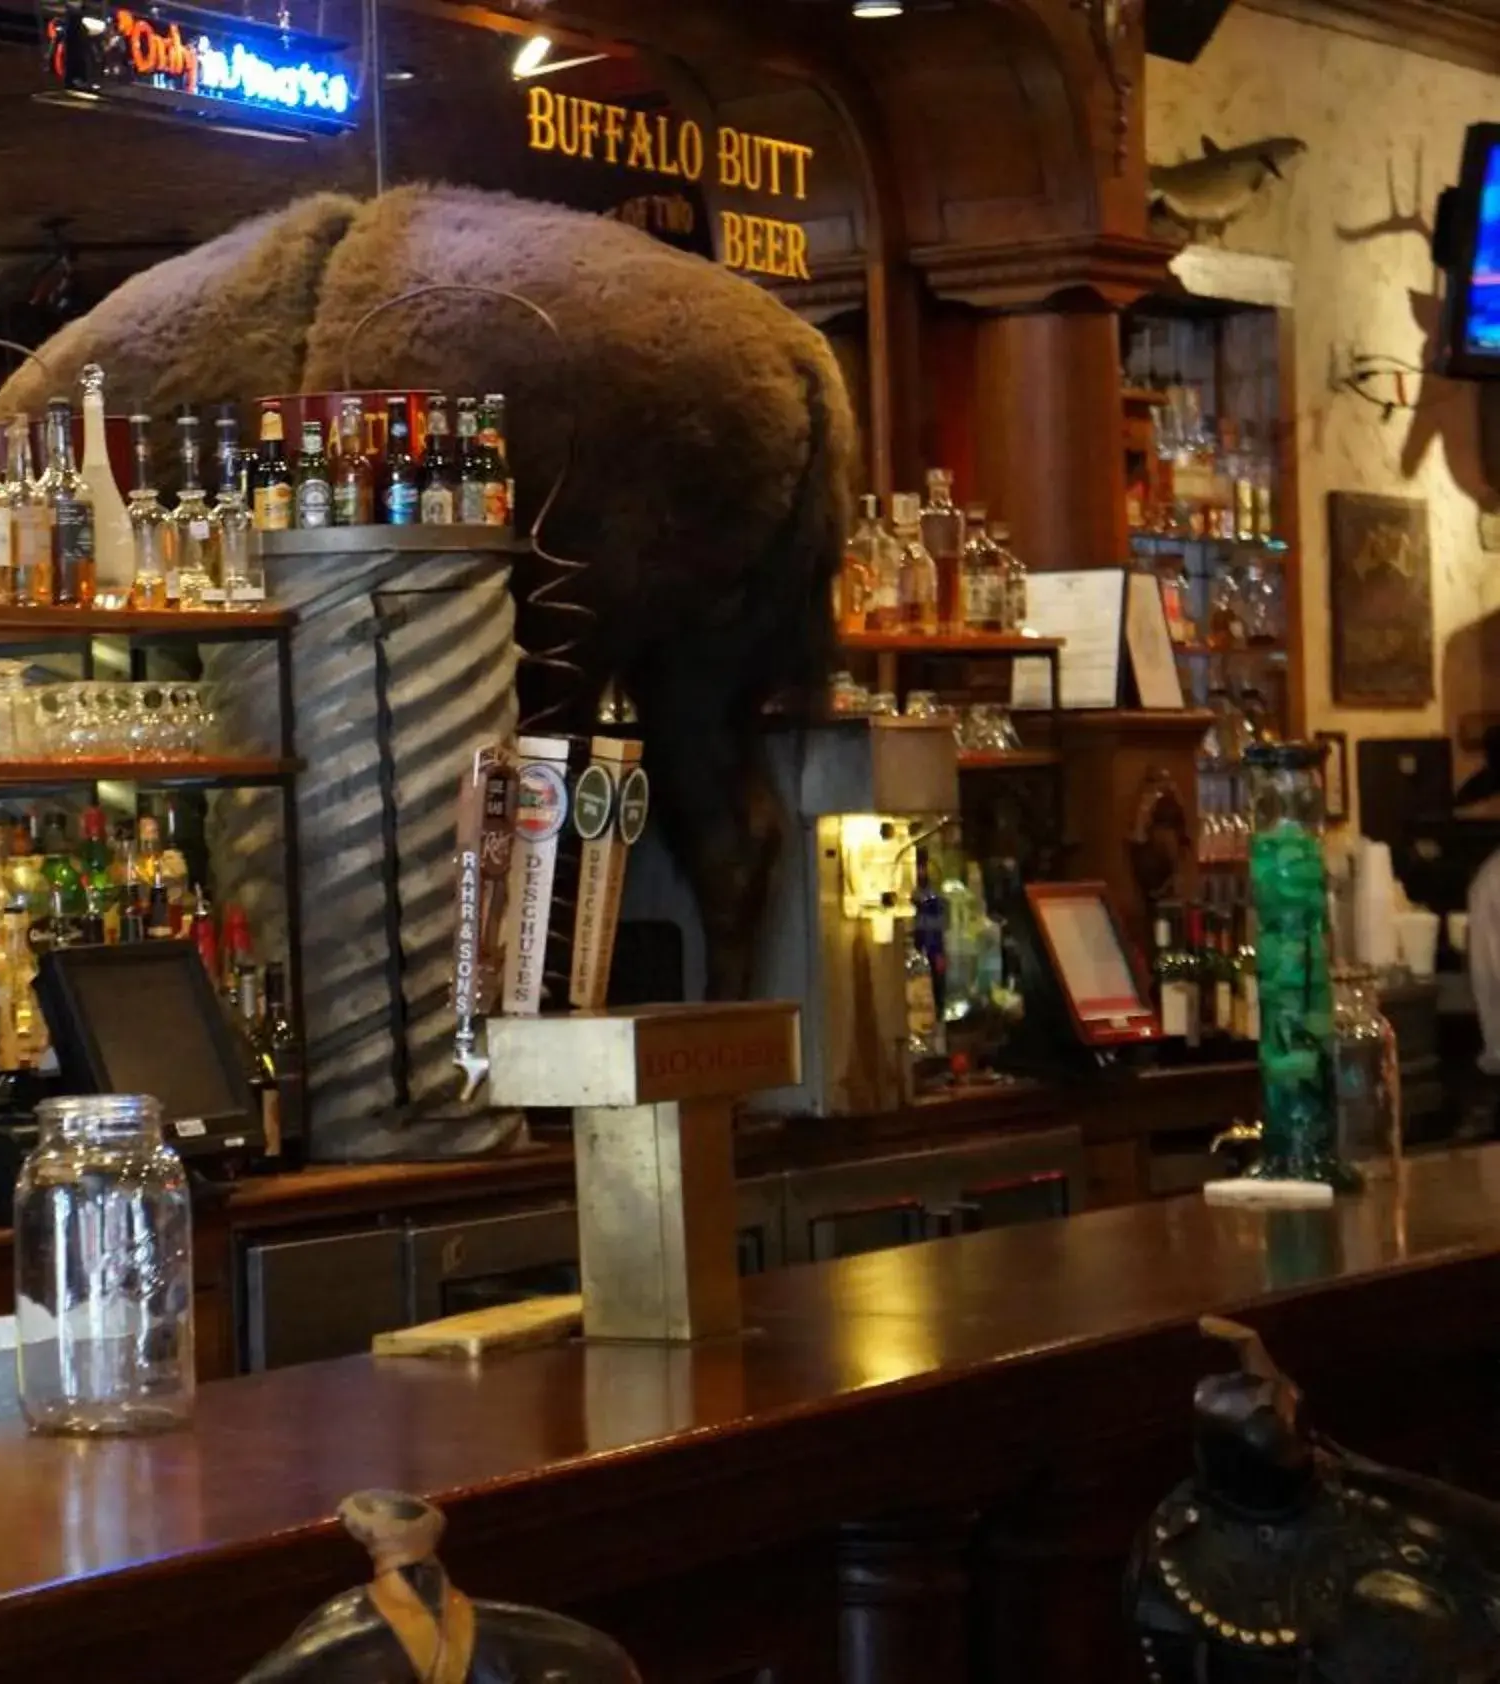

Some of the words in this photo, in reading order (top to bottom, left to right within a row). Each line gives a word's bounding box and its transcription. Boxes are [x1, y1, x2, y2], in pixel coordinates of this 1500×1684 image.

[527, 86, 702, 180] BUFFALO
[717, 127, 813, 199] BUTT
[720, 211, 810, 280] BEER
